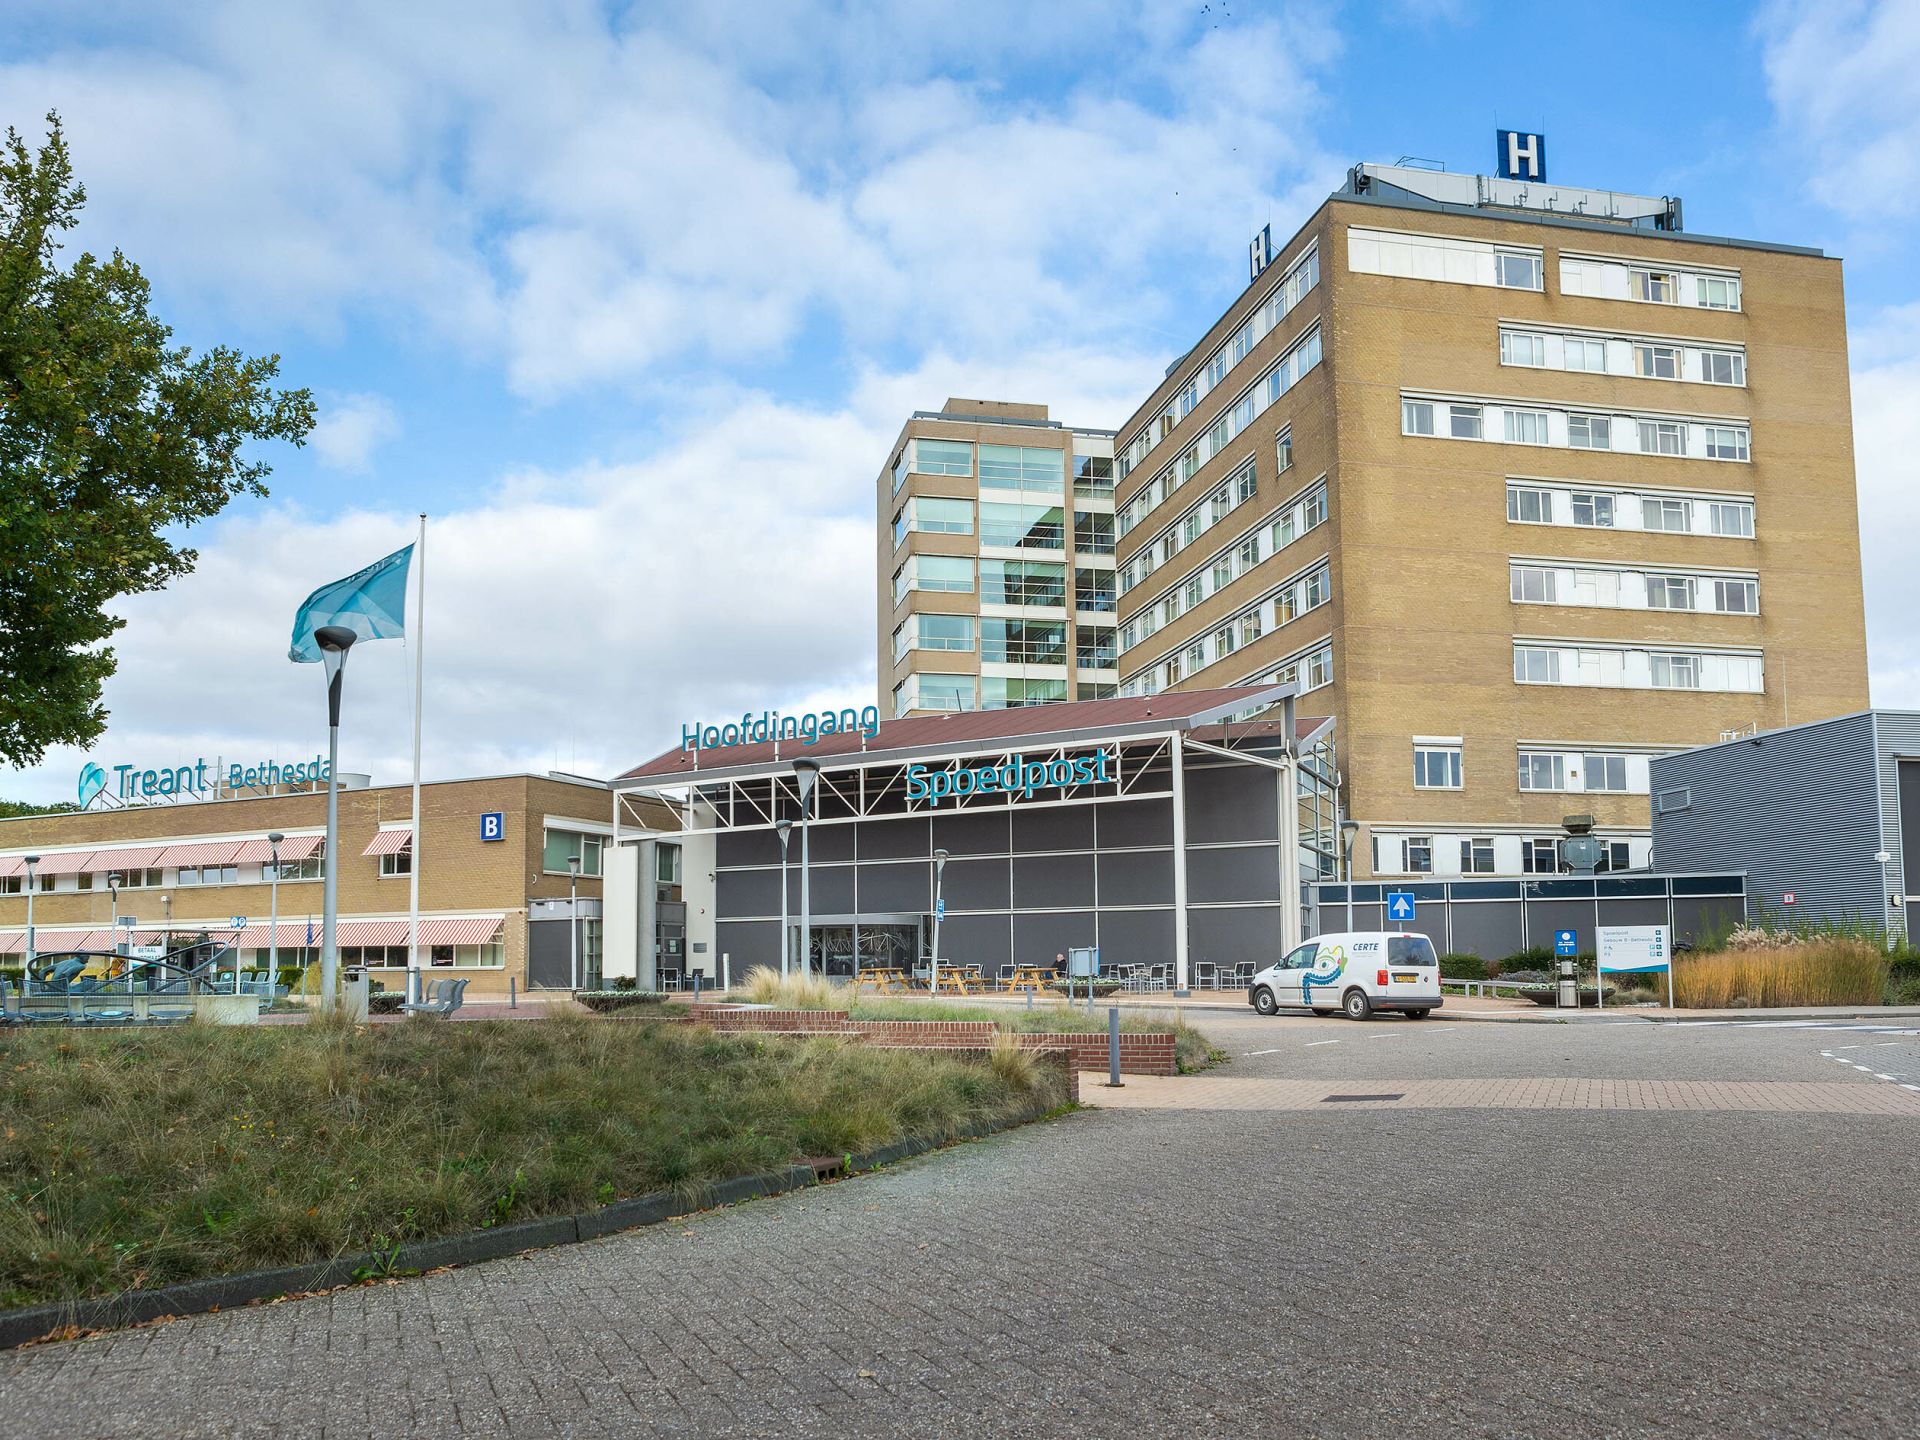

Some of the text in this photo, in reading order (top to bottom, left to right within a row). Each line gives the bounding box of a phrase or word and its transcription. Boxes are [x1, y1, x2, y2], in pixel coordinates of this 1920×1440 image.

[1508, 132, 1538, 177] H
[1251, 231, 1266, 278] H
[681, 705, 880, 752] Hoofdingang
[114, 758, 207, 798] Treant
[907, 748, 1111, 806] Spoedpost
[485, 816, 498, 837] B
[1353, 943, 1379, 951] CERTE
